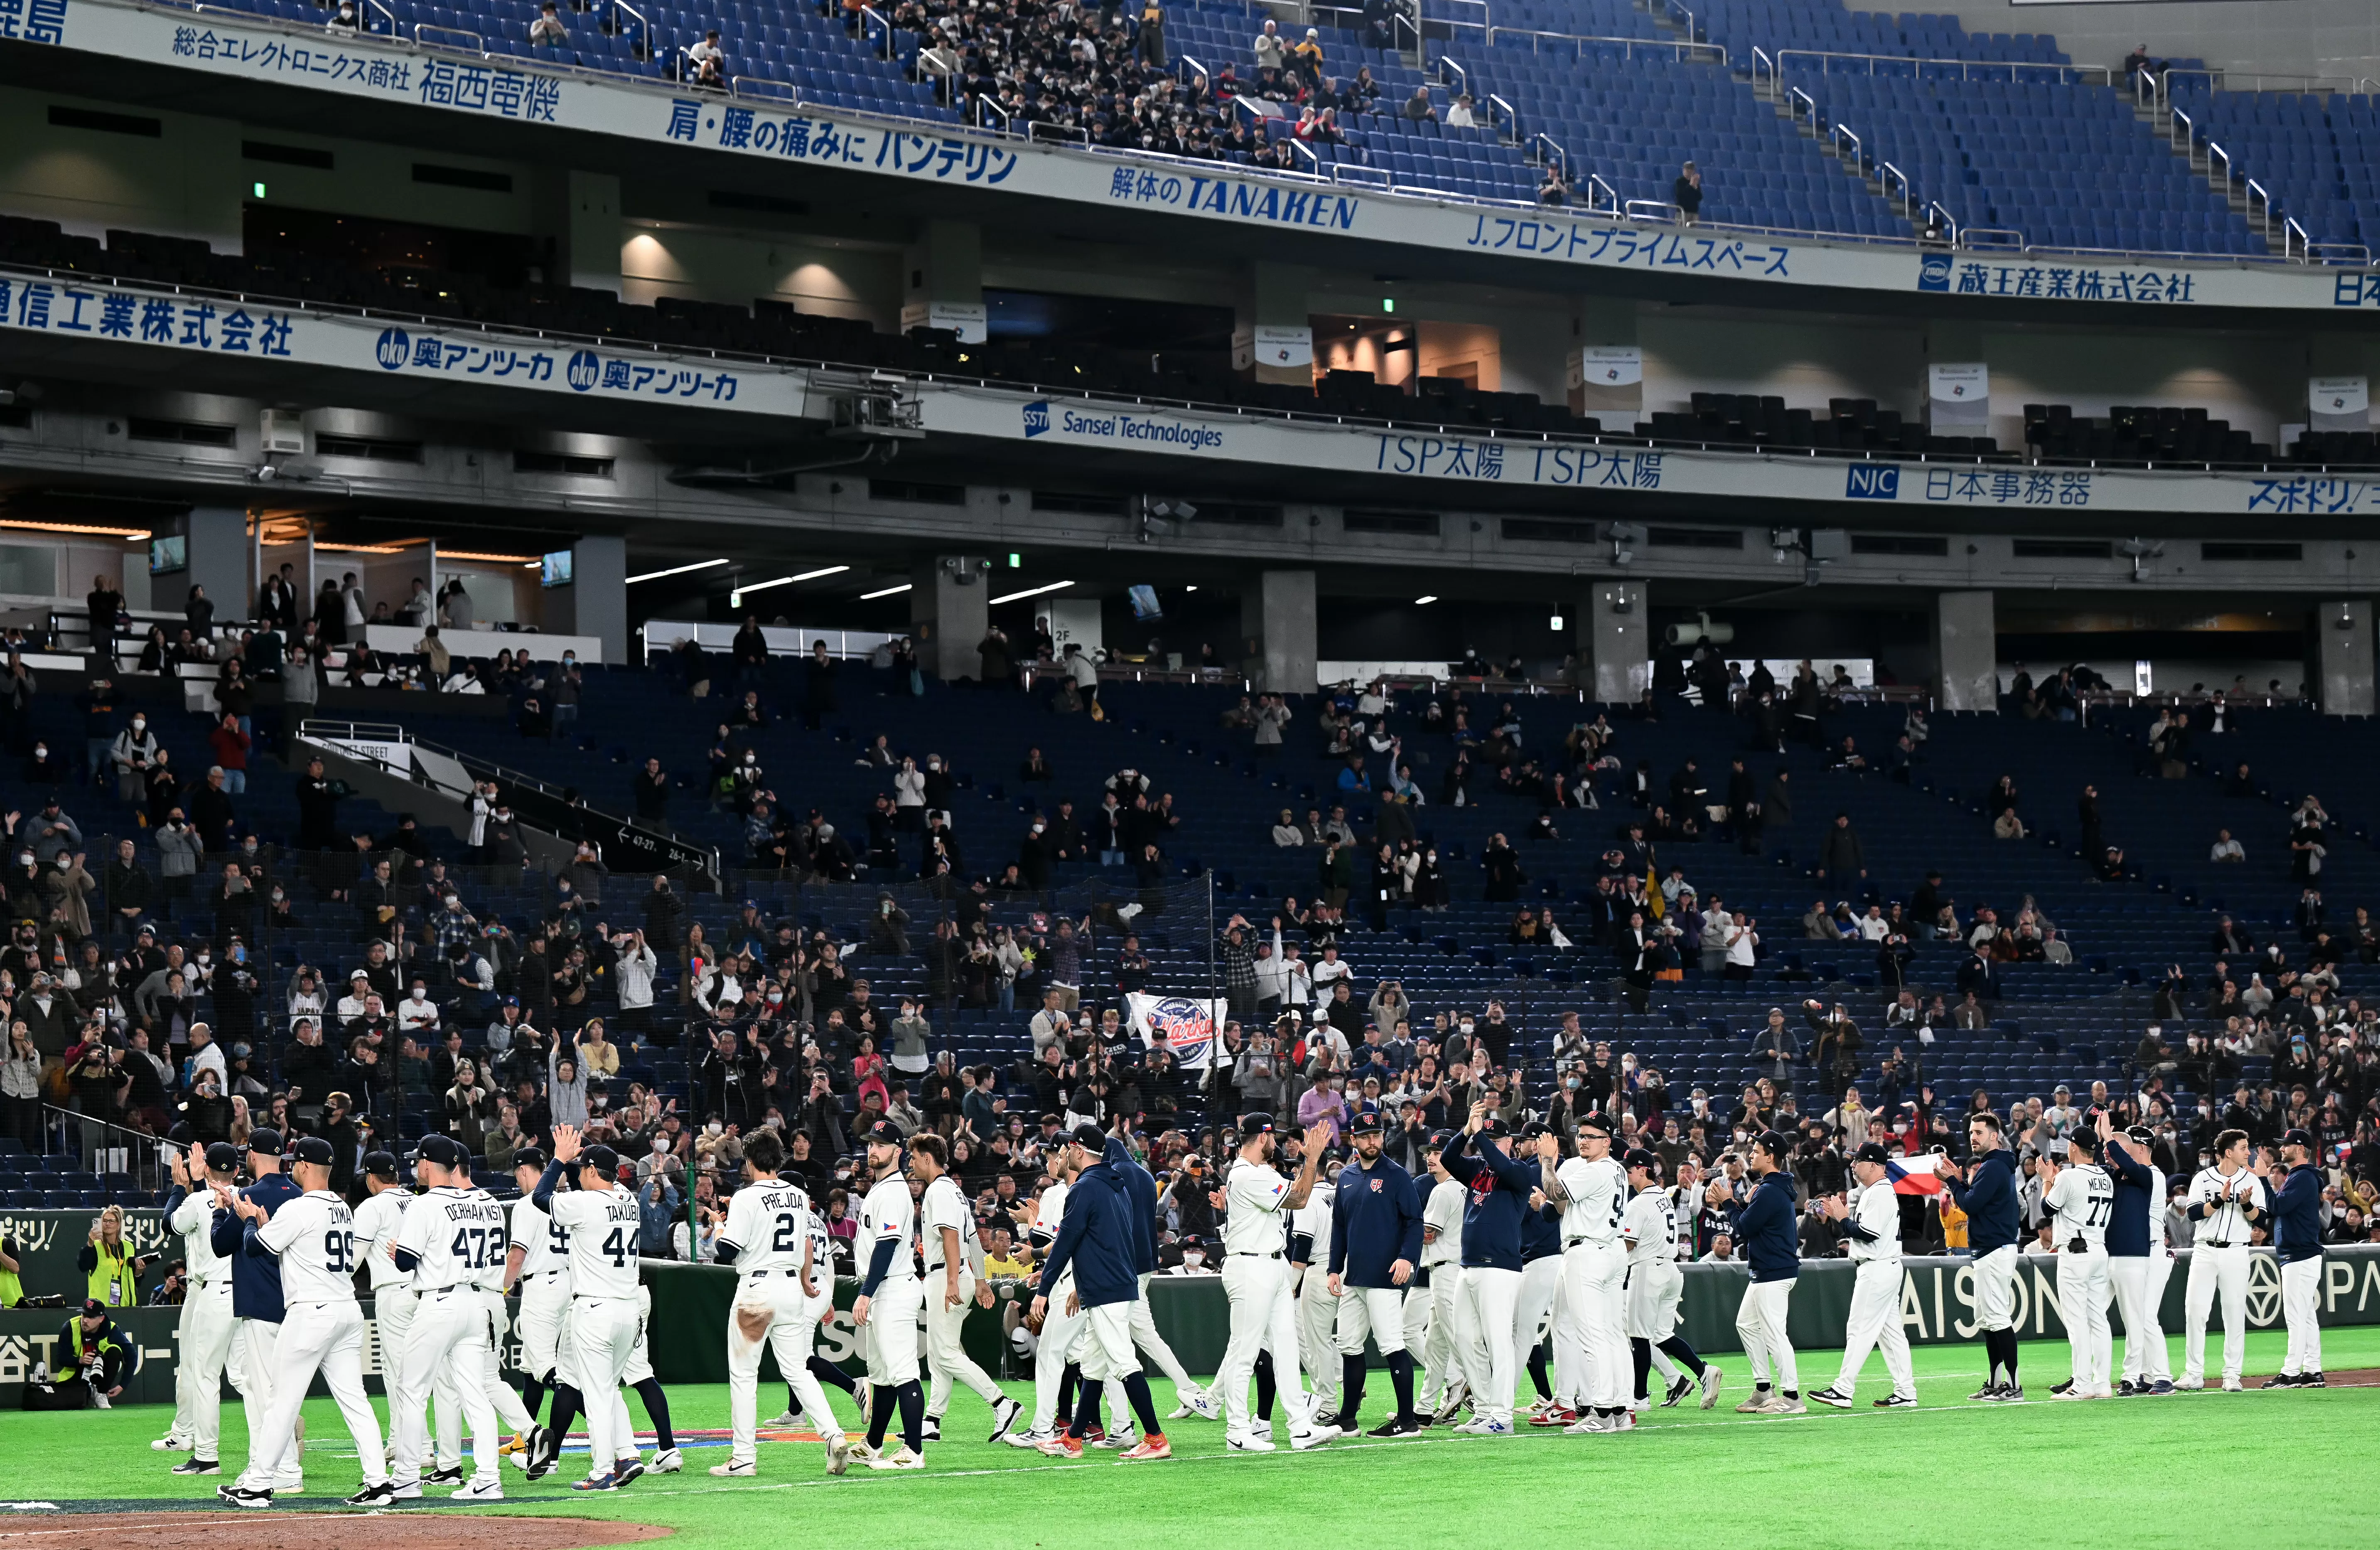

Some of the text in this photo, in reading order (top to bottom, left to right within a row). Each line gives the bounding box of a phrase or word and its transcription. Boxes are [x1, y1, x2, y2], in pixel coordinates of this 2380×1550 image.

[172, 25, 560, 122] 総合エレクトロニクス商社 福西電機
[875, 130, 1017, 184] バンテリン
[1187, 177, 1358, 229] TANAKEN
[1957, 263, 2196, 303] 蔵王産業株式会社
[412, 337, 553, 381] 奥アンツーカ
[602, 359, 738, 401] 奥アンツーカ
[1063, 411, 1223, 450] Sansei Technologies
[1373, 433, 1504, 480] TSP太陽
[1528, 445, 1663, 488] TSP太陽
[1850, 468, 1896, 495] NJC
[1926, 467, 2091, 506] 日本事務器
[1056, 630, 1070, 642] 2F
[361, 746, 388, 758] STREET
[759, 1192, 803, 1211] PREJDA
[2085, 1176, 2112, 1193] MENŠÍK
[605, 1206, 640, 1222] TAKUBO
[1665, 1213, 1675, 1244] 5
[2085, 1196, 2113, 1228] 77
[324, 1230, 355, 1273] 99
[451, 1227, 485, 1269] 47
[602, 1227, 640, 1268] 44
[772, 1213, 794, 1252] 2
